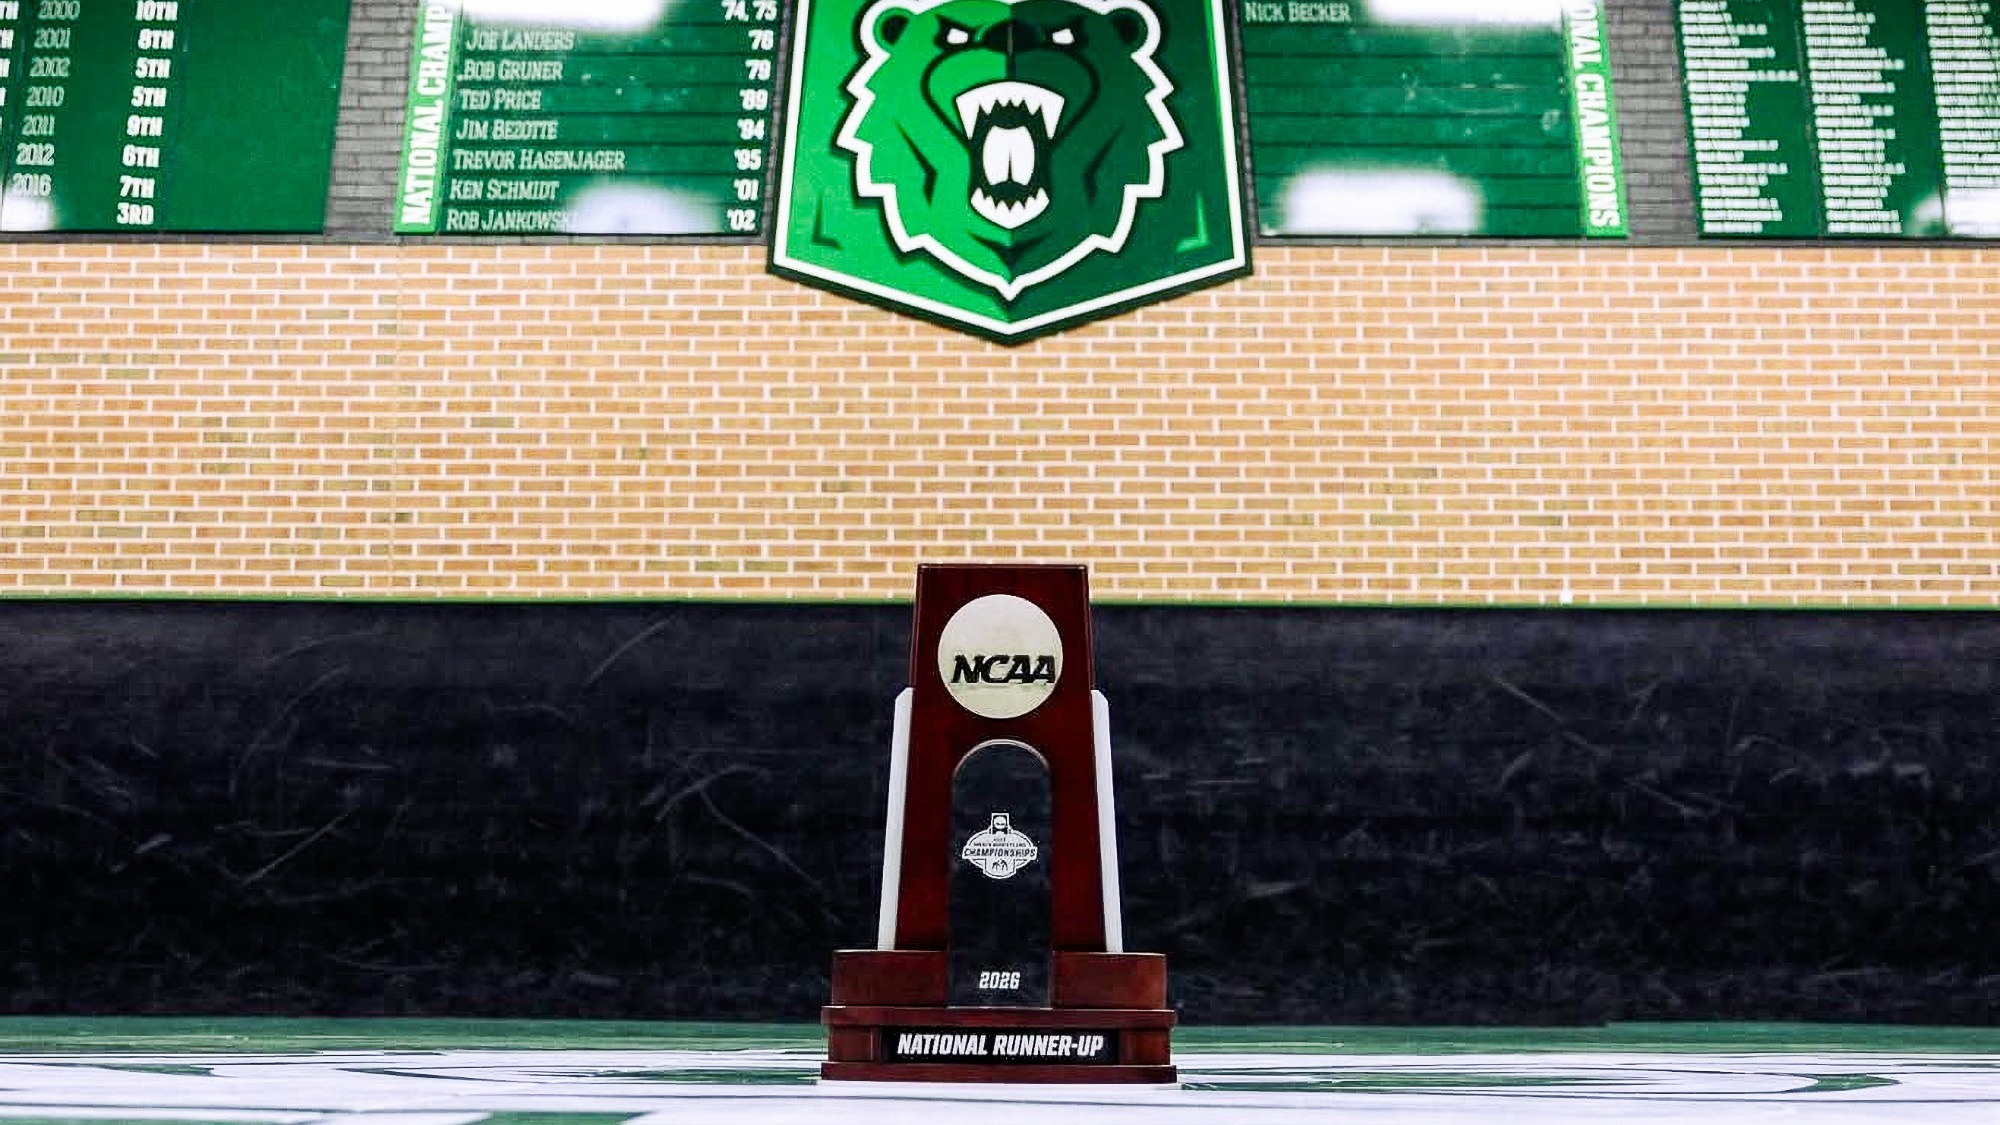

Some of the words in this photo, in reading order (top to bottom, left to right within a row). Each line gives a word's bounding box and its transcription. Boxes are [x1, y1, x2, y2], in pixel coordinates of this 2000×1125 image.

[38, 1, 80, 20] 2000
[136, 1, 178, 21] 10TH
[1245, 2, 1285, 22] NICK
[1288, 2, 1351, 22] BECKER
[34, 28, 70, 49] 2001
[465, 29, 499, 50] JOE
[502, 29, 574, 51] LANDERS
[30, 57, 70, 77] 2002
[135, 57, 171, 78] 5TH
[464, 60, 495, 80] BOB
[498, 60, 563, 81] GRUNER
[27, 86, 64, 107] 2010
[131, 85, 166, 107] 5TH
[460, 89, 490, 110] TED
[493, 89, 542, 110] PRICE
[22, 114, 55, 136] 2011
[127, 114, 163, 136] 9TH
[456, 118, 488, 140] JIM
[491, 118, 558, 140] BEZOTTE
[16, 143, 54, 165] 2012
[122, 144, 160, 167] 6TH
[452, 149, 515, 170] TREVOR
[519, 149, 626, 171] HASENJAGER
[734, 148, 762, 171] '95
[1575, 73, 1621, 227] CHAMPIONS
[401, 99, 443, 224] NATIONAL
[12, 172, 52, 197] 2016
[120, 175, 155, 198] 7TH
[450, 178, 483, 200] KEN
[487, 178, 560, 200] SCHMIDT
[733, 179, 759, 200] '01
[116, 202, 154, 225] 3RD
[446, 209, 480, 231] ROB
[481, 209, 578, 232] JANKOWSK
[727, 209, 756, 231] '02
[951, 654, 1056, 684] NCAA
[964, 848, 1036, 857] CHAMPIONSHIPS
[979, 971, 1021, 990] 2026
[897, 1033, 988, 1056] NATIONAL
[993, 1035, 1104, 1057] RUNNER-UP
